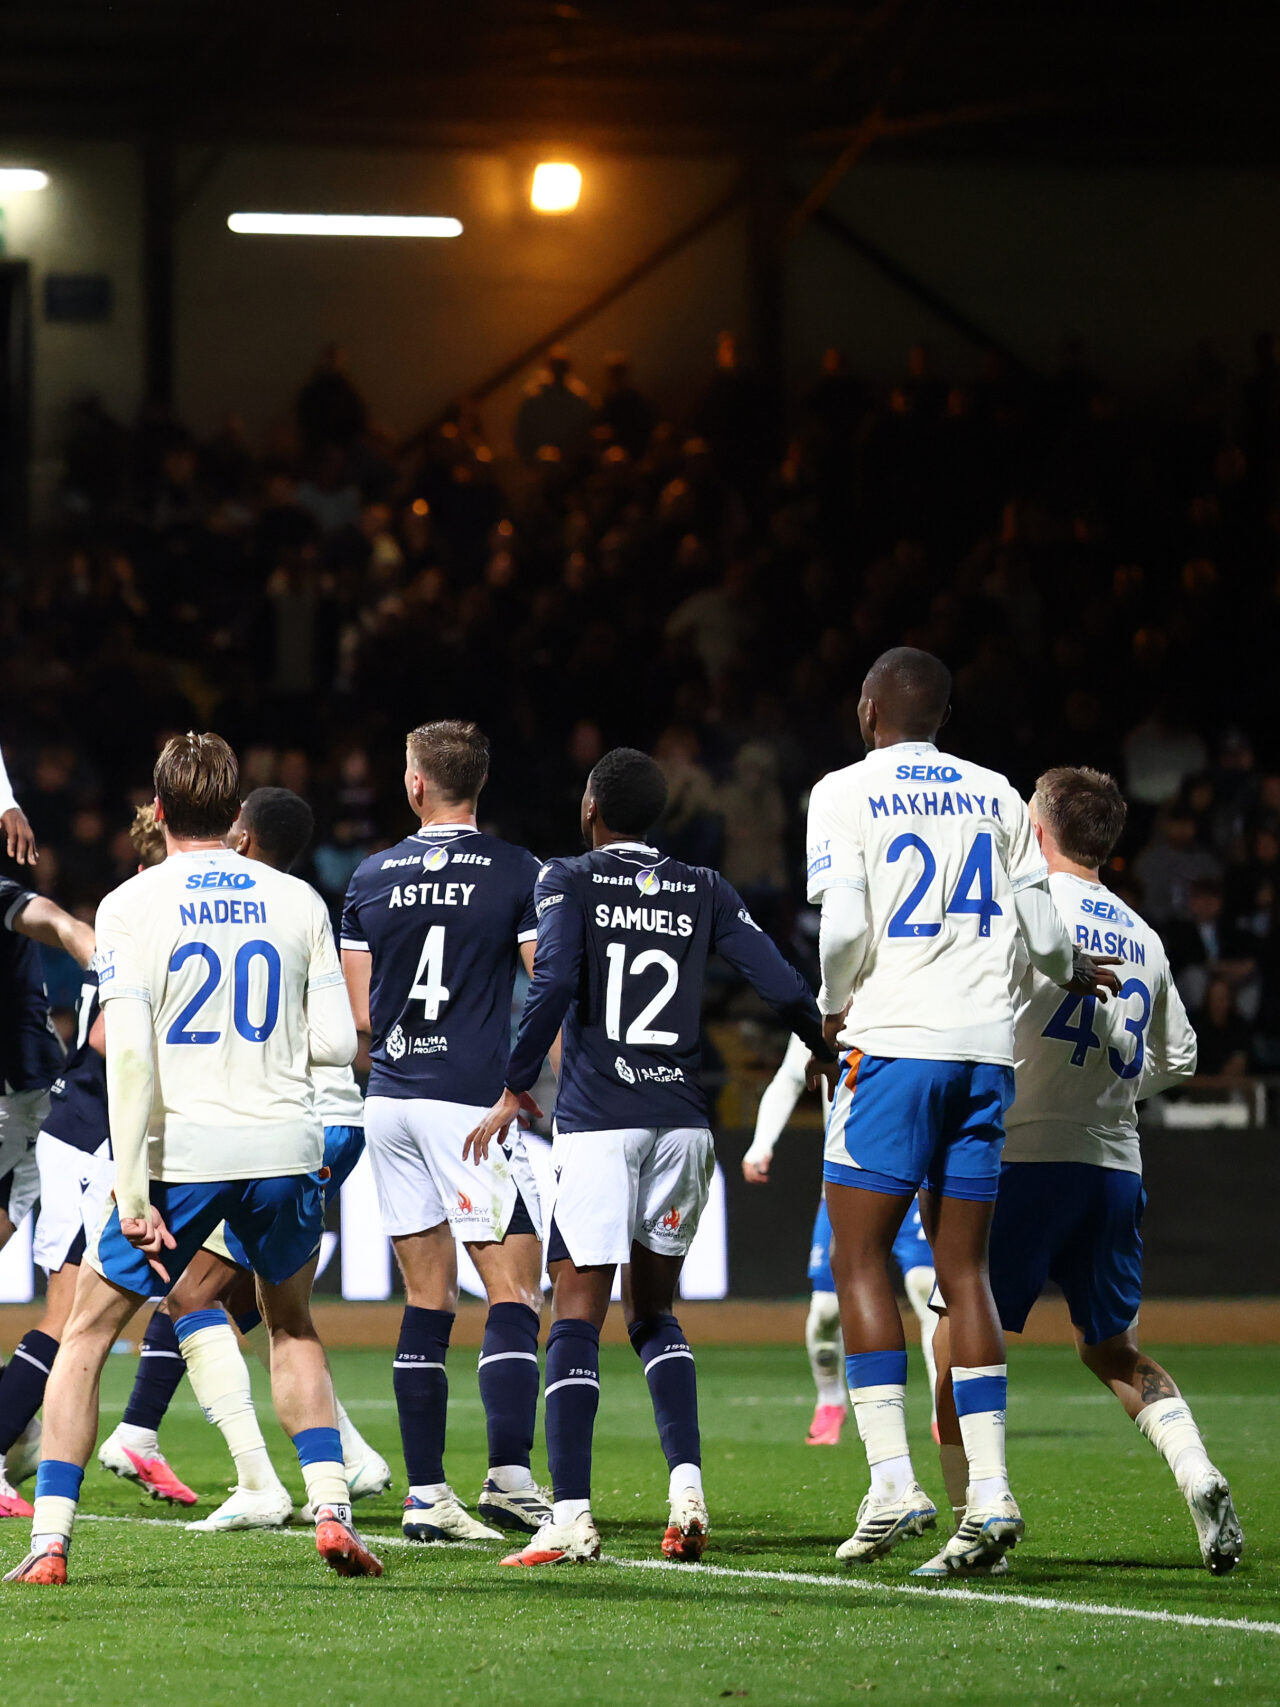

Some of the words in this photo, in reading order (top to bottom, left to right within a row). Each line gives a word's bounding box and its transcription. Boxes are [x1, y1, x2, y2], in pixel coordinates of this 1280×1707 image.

[896, 765, 962, 783] SEKO
[868, 791, 1004, 823] MAKHANYA
[380, 854, 422, 870] Drain
[450, 853, 493, 867] Blitz
[185, 871, 256, 890] SEKO
[388, 882, 476, 909] ASTLEY
[592, 873, 634, 886] Drain
[661, 879, 697, 893] Blitz
[886, 832, 1004, 938] 24
[179, 899, 268, 926] NADERI
[595, 903, 694, 938] SAMUELS
[1080, 898, 1135, 928] SEKO
[1076, 924, 1146, 967] RASKIN
[407, 924, 451, 1021] 4
[165, 939, 281, 1045] 20
[605, 942, 680, 1046] 12
[1040, 977, 1151, 1080] 43
